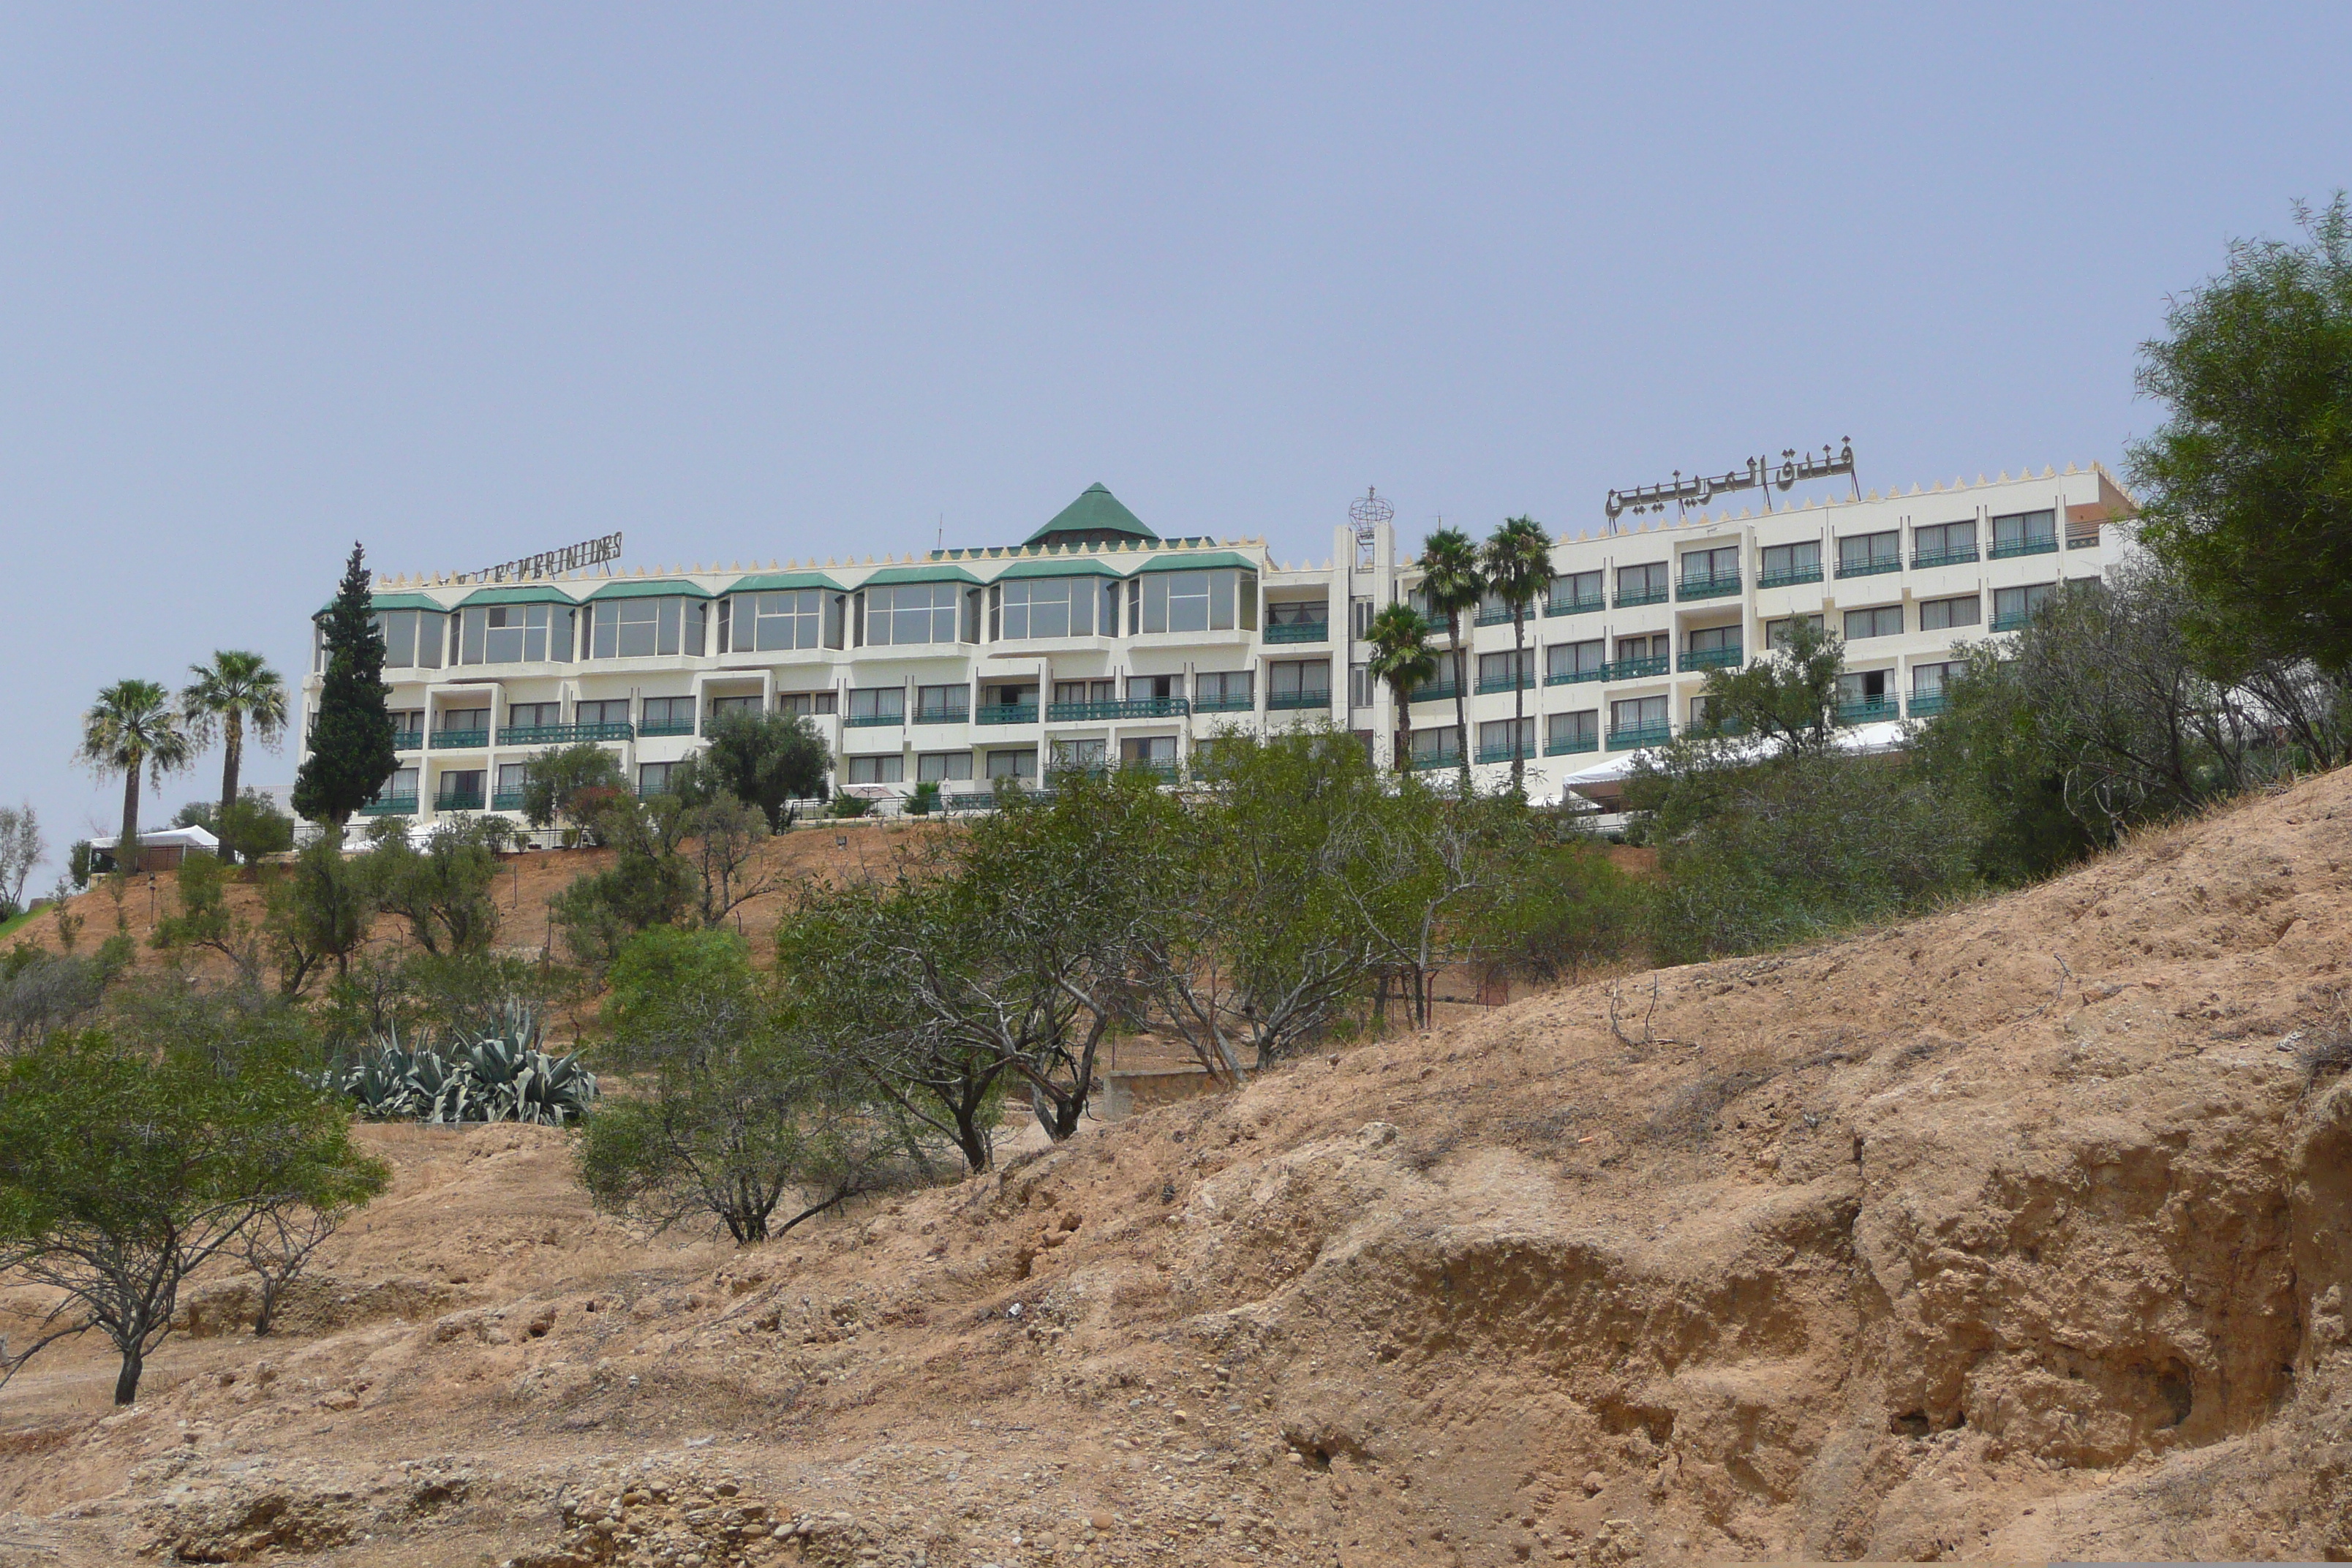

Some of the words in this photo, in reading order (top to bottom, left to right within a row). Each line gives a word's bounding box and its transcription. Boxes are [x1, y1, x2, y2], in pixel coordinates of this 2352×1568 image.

[1605, 454, 1766, 519] المرينيين
[1776, 434, 1855, 492] فندق
[517, 531, 622, 581] MERINIDES
